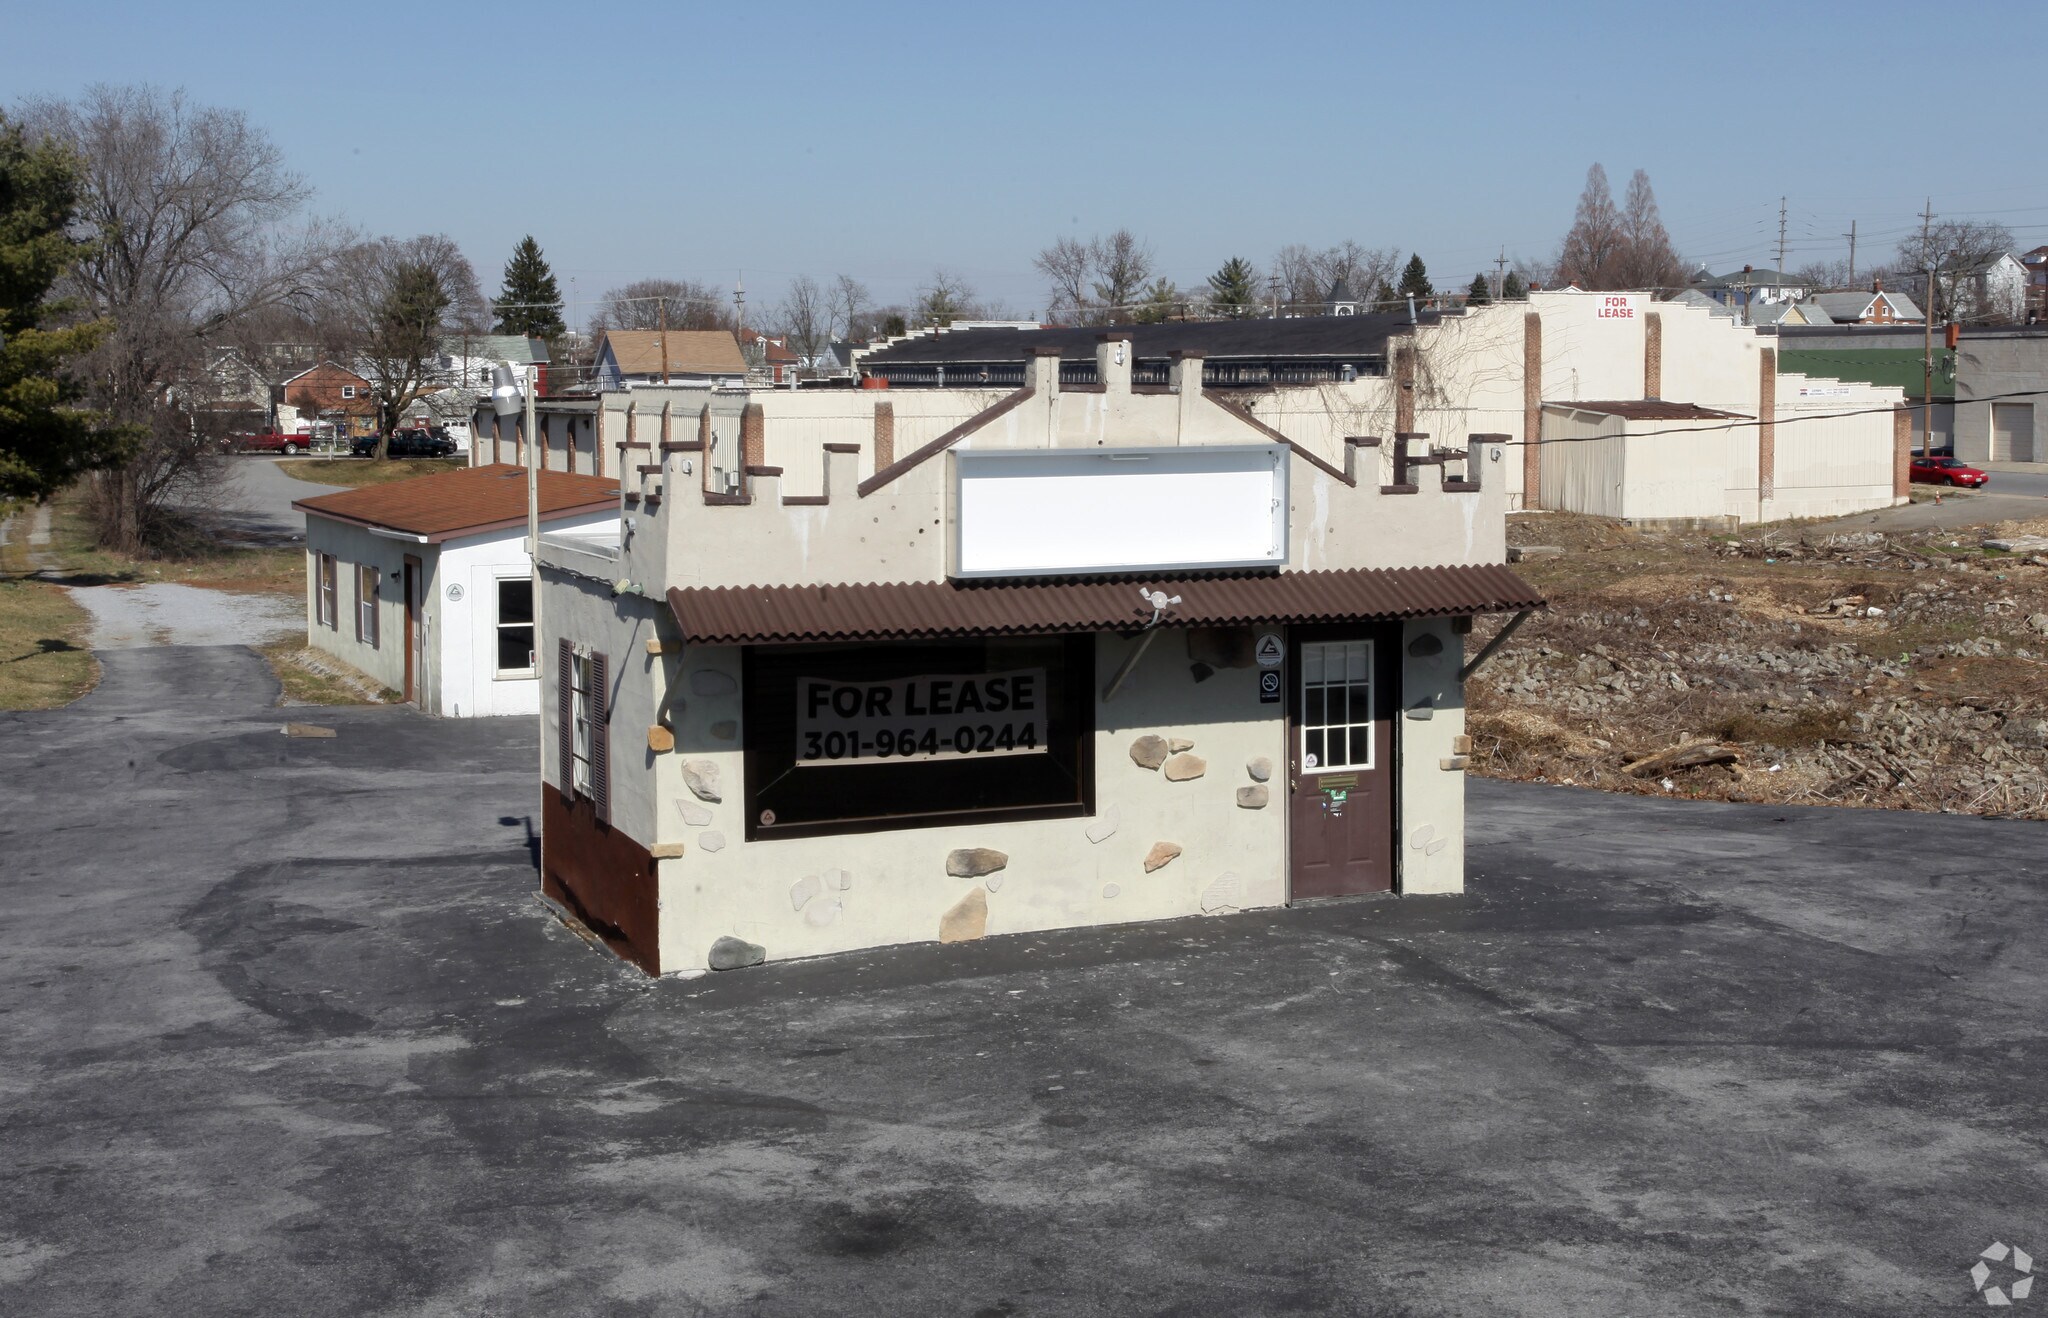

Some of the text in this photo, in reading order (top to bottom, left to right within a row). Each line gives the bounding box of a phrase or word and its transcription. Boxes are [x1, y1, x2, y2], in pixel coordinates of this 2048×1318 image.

[1598, 308, 1634, 318] LEASE
[1605, 297, 1627, 307] FOR
[807, 676, 1034, 719] FOR LEASE
[803, 722, 1037, 760] 301-964-0244
